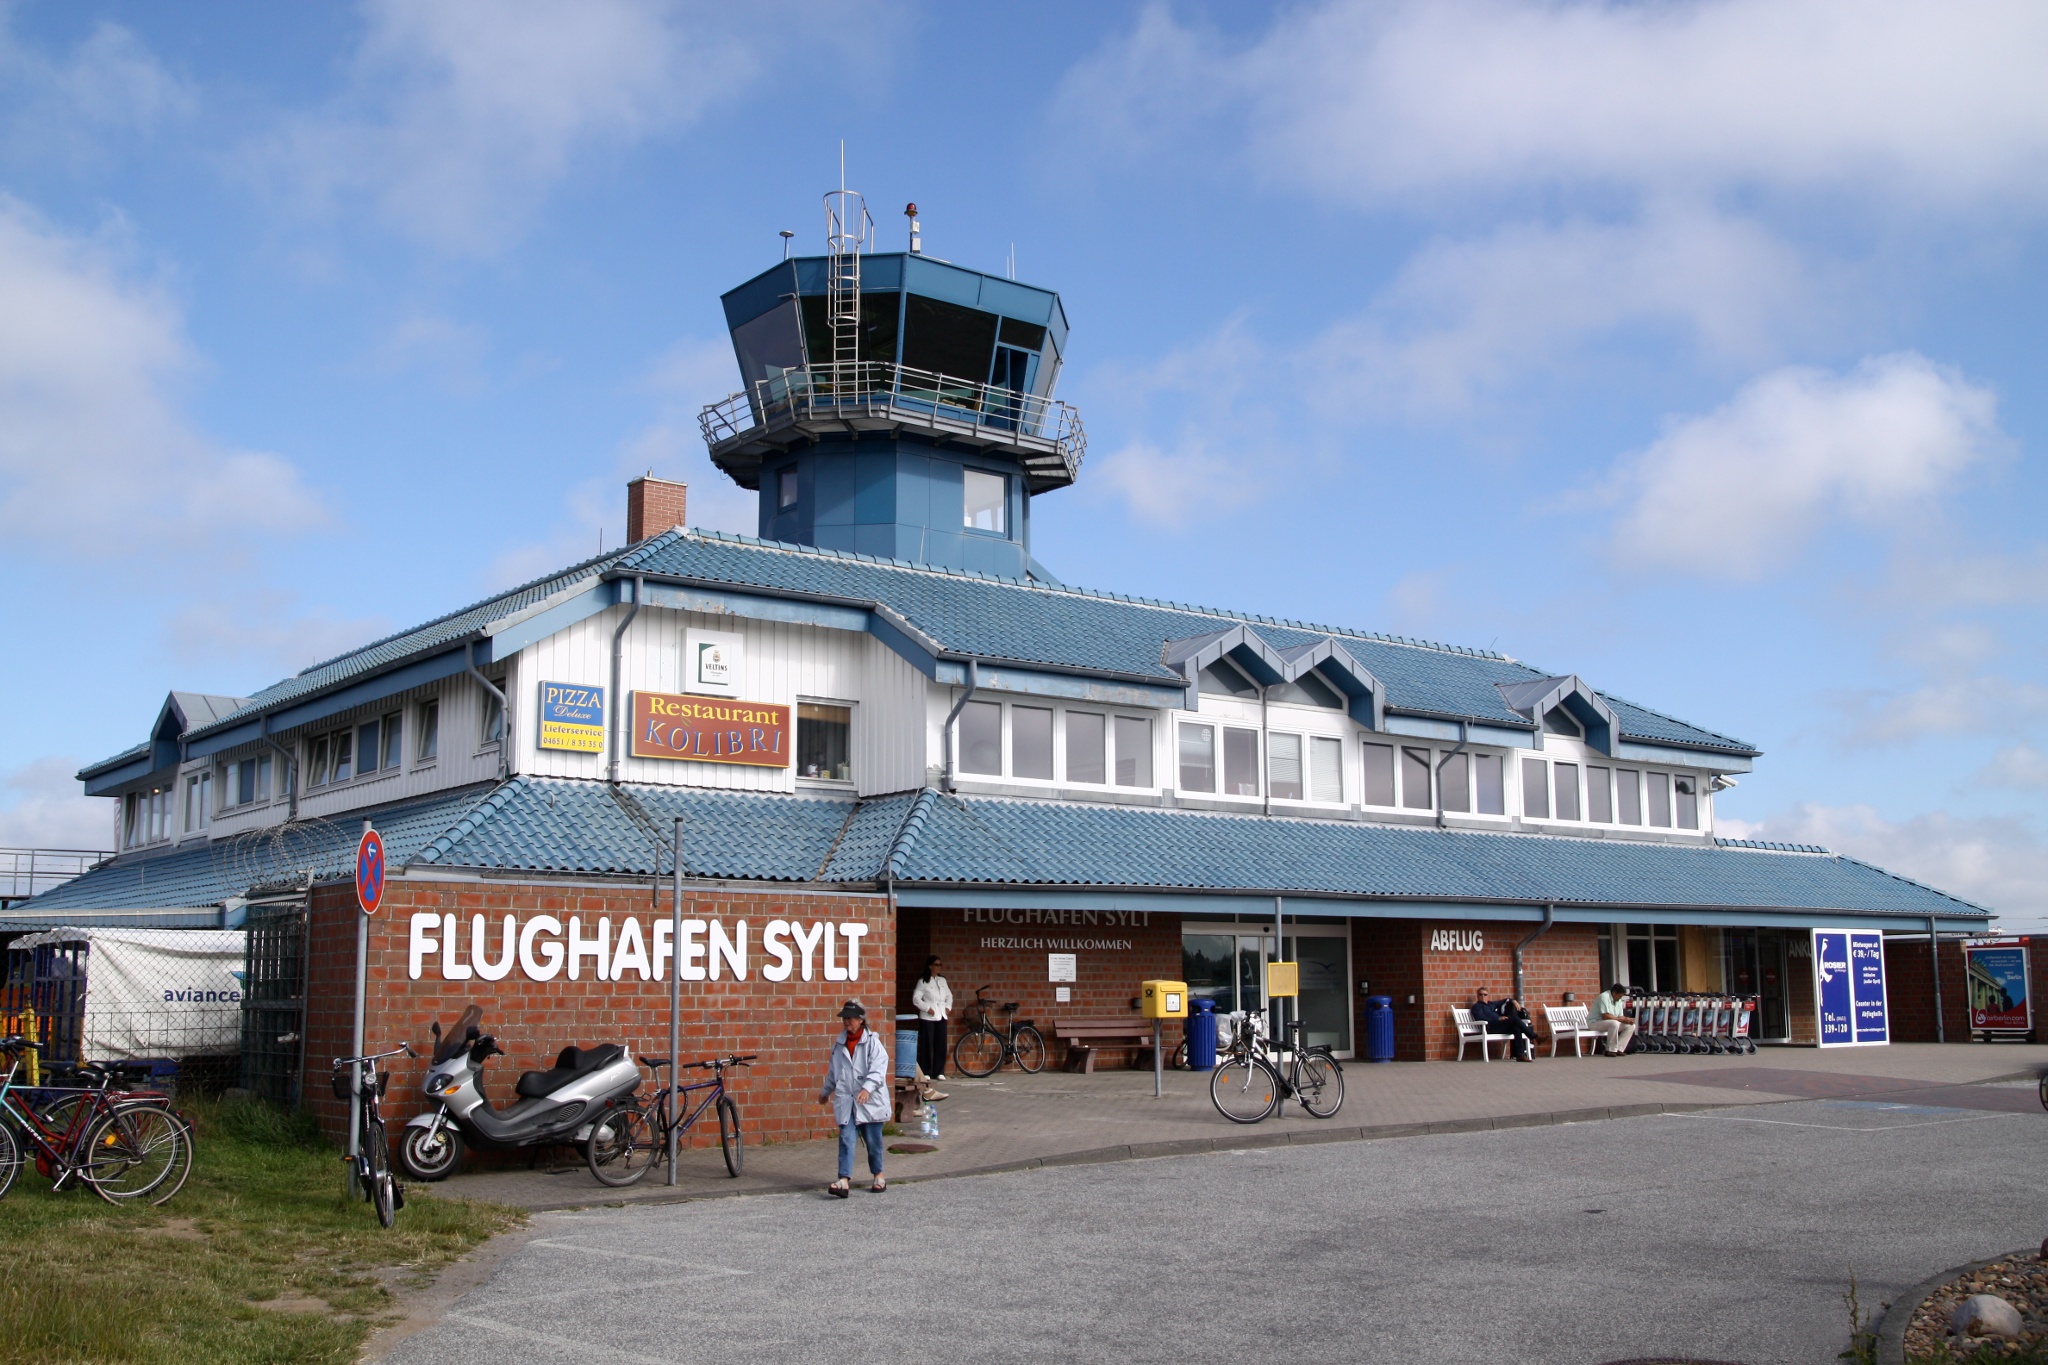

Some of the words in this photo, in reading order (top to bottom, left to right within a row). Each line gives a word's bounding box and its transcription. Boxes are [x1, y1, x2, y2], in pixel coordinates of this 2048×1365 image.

[705, 663, 728, 672] VELTINS
[546, 687, 602, 709] PIZZA
[553, 705, 592, 720] Deluxe
[649, 697, 780, 726] Restaurant
[544, 724, 603, 737] Lieferservice
[644, 718, 782, 757] KOLIBRI
[543, 737, 564, 746] 04651
[571, 739, 576, 747] 8
[578, 739, 586, 748] 35
[588, 740, 597, 749] 35
[963, 908, 1098, 926] FLUGHAFEN
[1105, 910, 1149, 927] SYLT
[408, 912, 747, 982] FLUGHAFEN
[762, 919, 868, 982] SYLT
[980, 937, 1044, 949] HERZLICH
[1046, 938, 1132, 950] WILLKOMMEN
[1430, 929, 1484, 952] ABFLUG
[1870, 949, 1880, 960] Tag
[1824, 961, 1846, 969] ROSIER
[164, 986, 241, 1002] aviance
[1824, 1012, 1836, 1022] Tel.
[1824, 1023, 1848, 1034] 339-120
